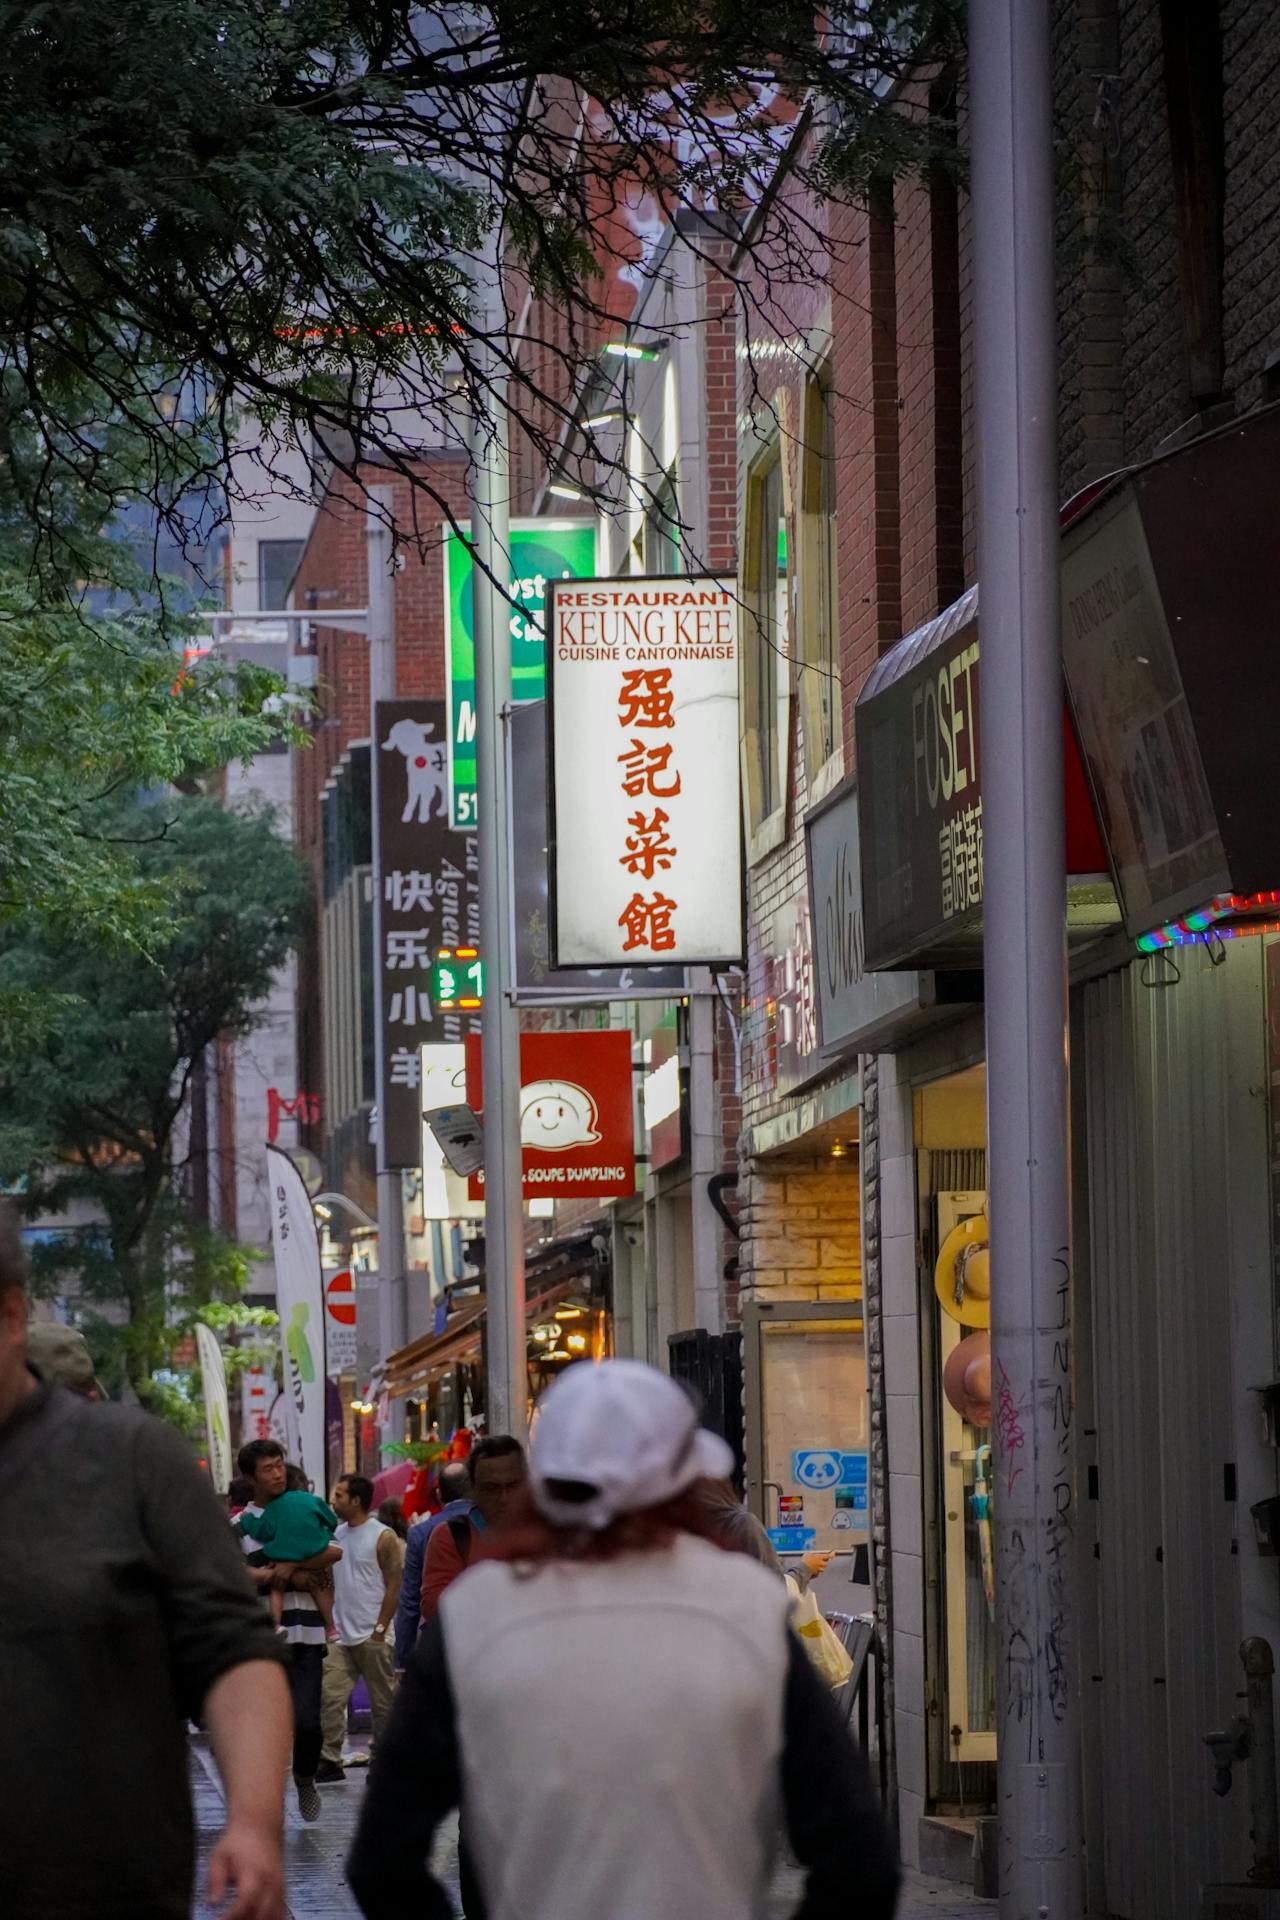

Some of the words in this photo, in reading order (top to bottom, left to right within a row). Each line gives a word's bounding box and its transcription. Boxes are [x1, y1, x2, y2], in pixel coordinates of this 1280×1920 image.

[557, 591, 734, 607] RESTAURANT
[558, 610, 665, 646] KEUNG
[674, 609, 733, 645] KEE
[558, 647, 621, 661] CUISINE
[625, 646, 735, 661] CANTONNAISE
[434, 857, 465, 947] Agnea
[527, 1167, 565, 1183] SOUPE
[566, 1166, 626, 1182] DUMPLING
